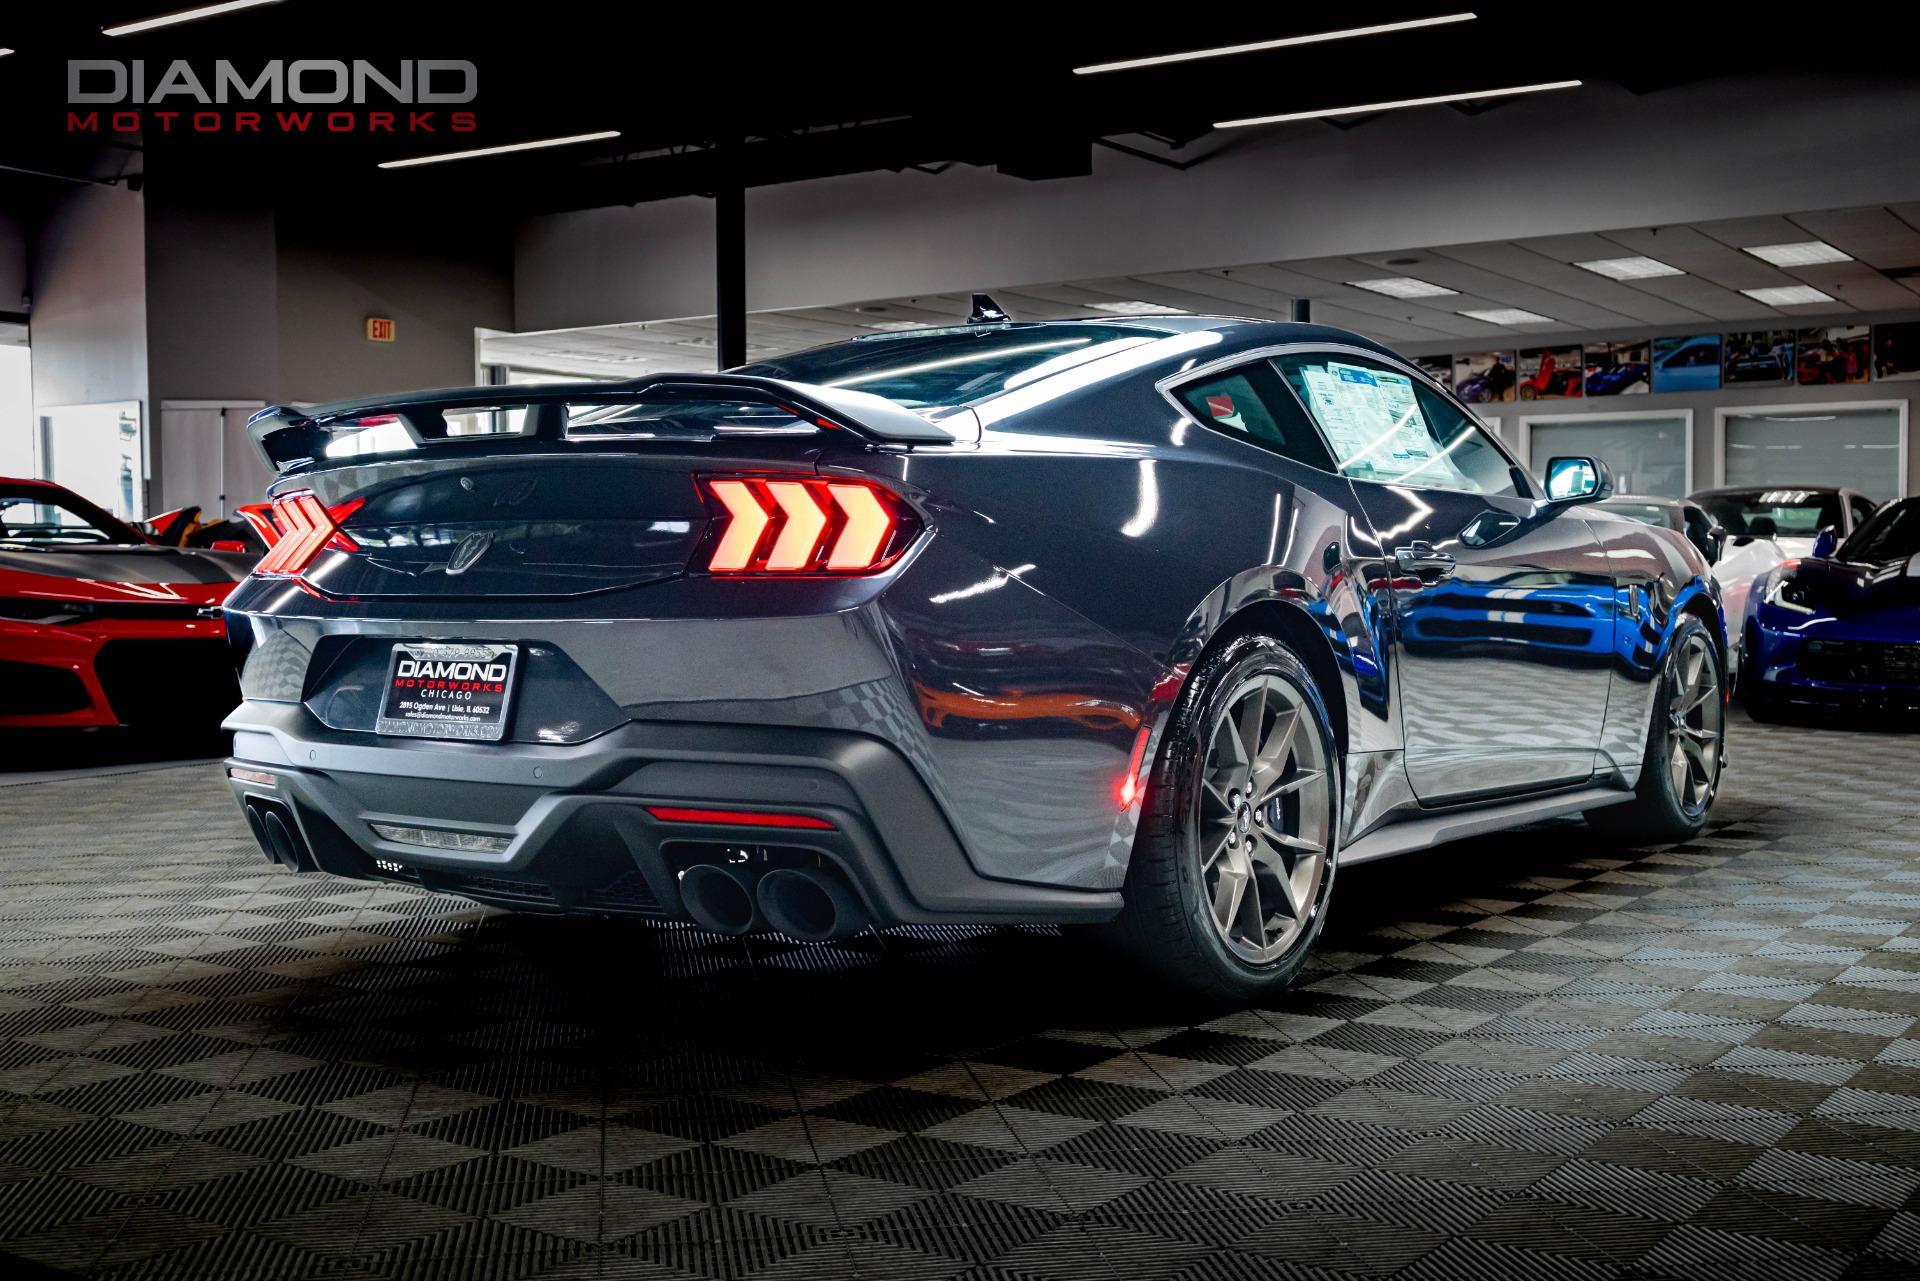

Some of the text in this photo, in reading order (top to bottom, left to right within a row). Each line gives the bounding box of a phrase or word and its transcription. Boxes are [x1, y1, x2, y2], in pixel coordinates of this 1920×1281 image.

[372, 319, 392, 339] EXIT
[397, 661, 507, 681] DIAMOND
[395, 680, 503, 692] MOTORWORKS
[420, 689, 472, 700] CHICAGO
[413, 702, 434, 711] Ogden
[433, 703, 446, 711] Ave
[472, 706, 490, 714] 60532
